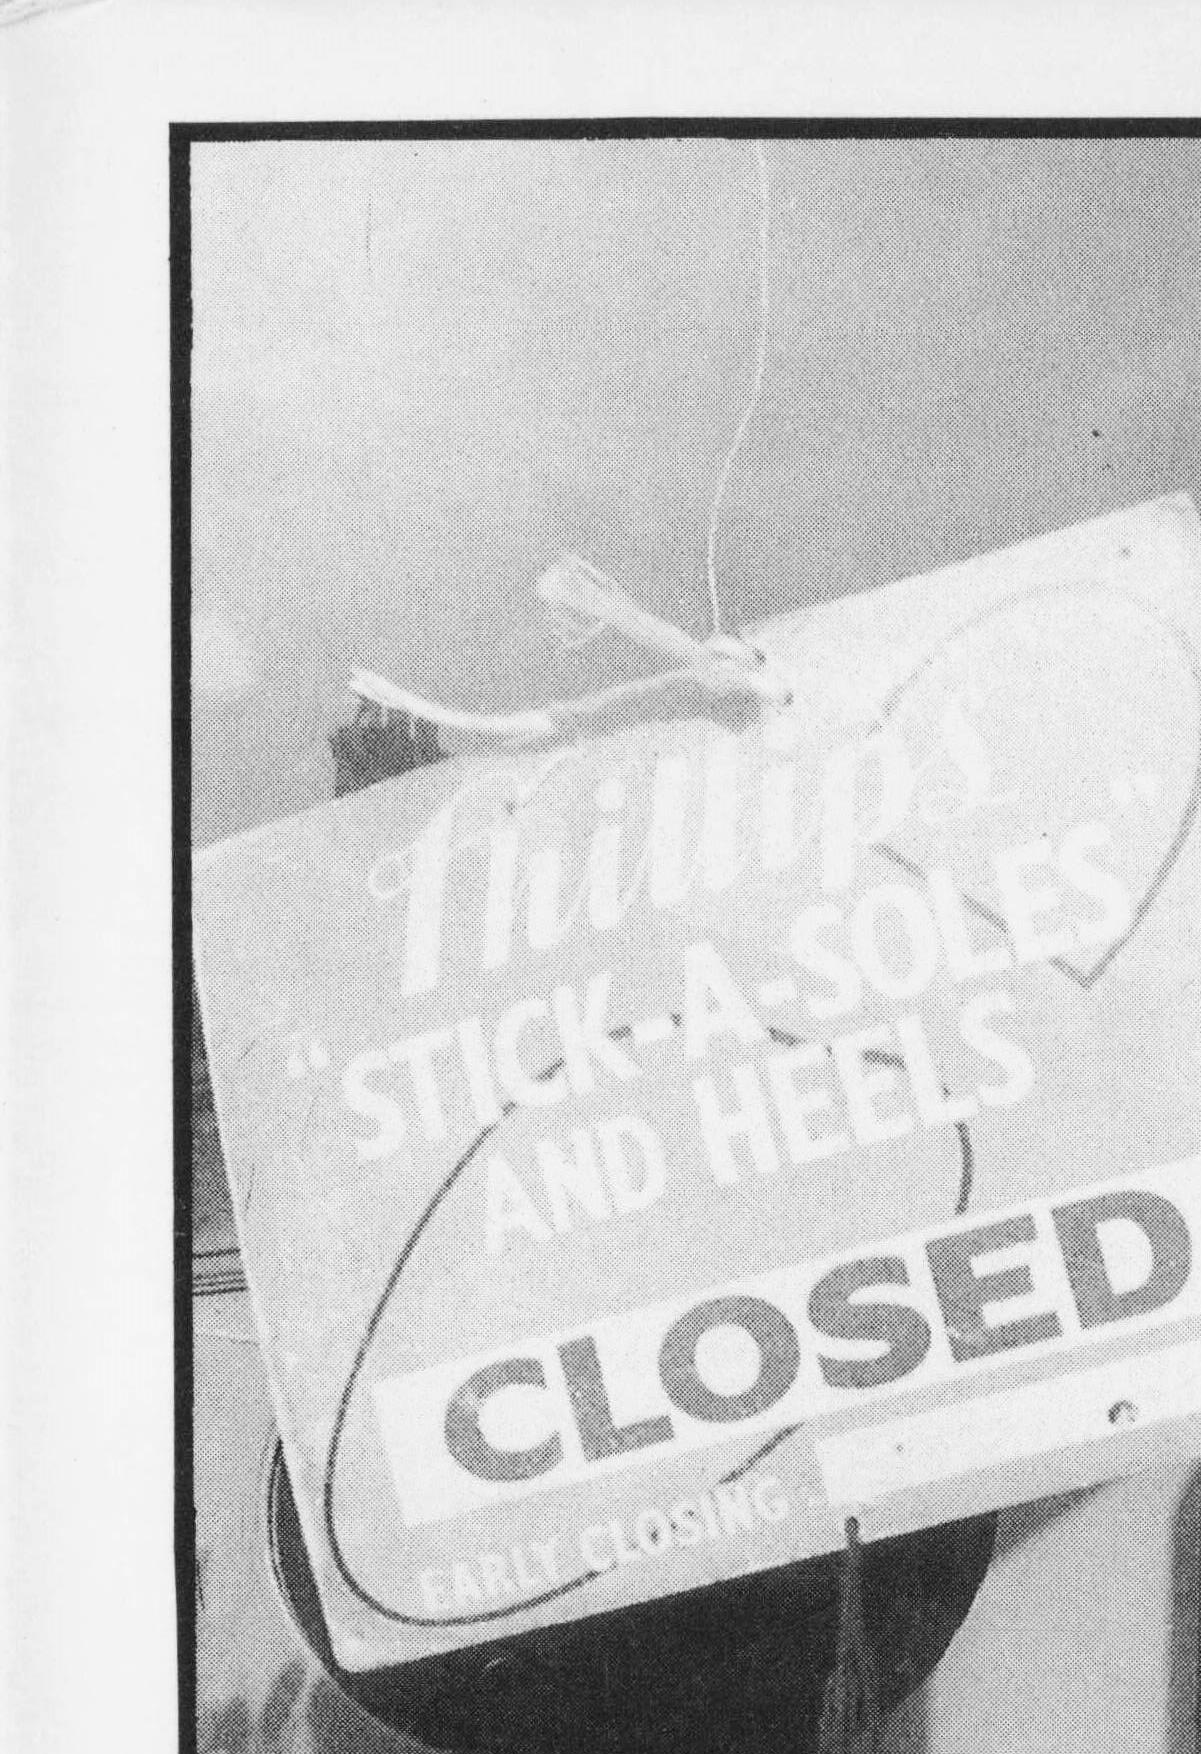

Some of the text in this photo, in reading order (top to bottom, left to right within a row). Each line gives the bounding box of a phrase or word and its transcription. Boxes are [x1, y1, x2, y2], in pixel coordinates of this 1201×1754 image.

[368, 690, 1018, 998] Phillips
[485, 996, 1036, 1254] AND HEELS
[442, 1189, 1194, 1484] CLOSED
[418, 1475, 790, 1614] EARLY CLOSING
